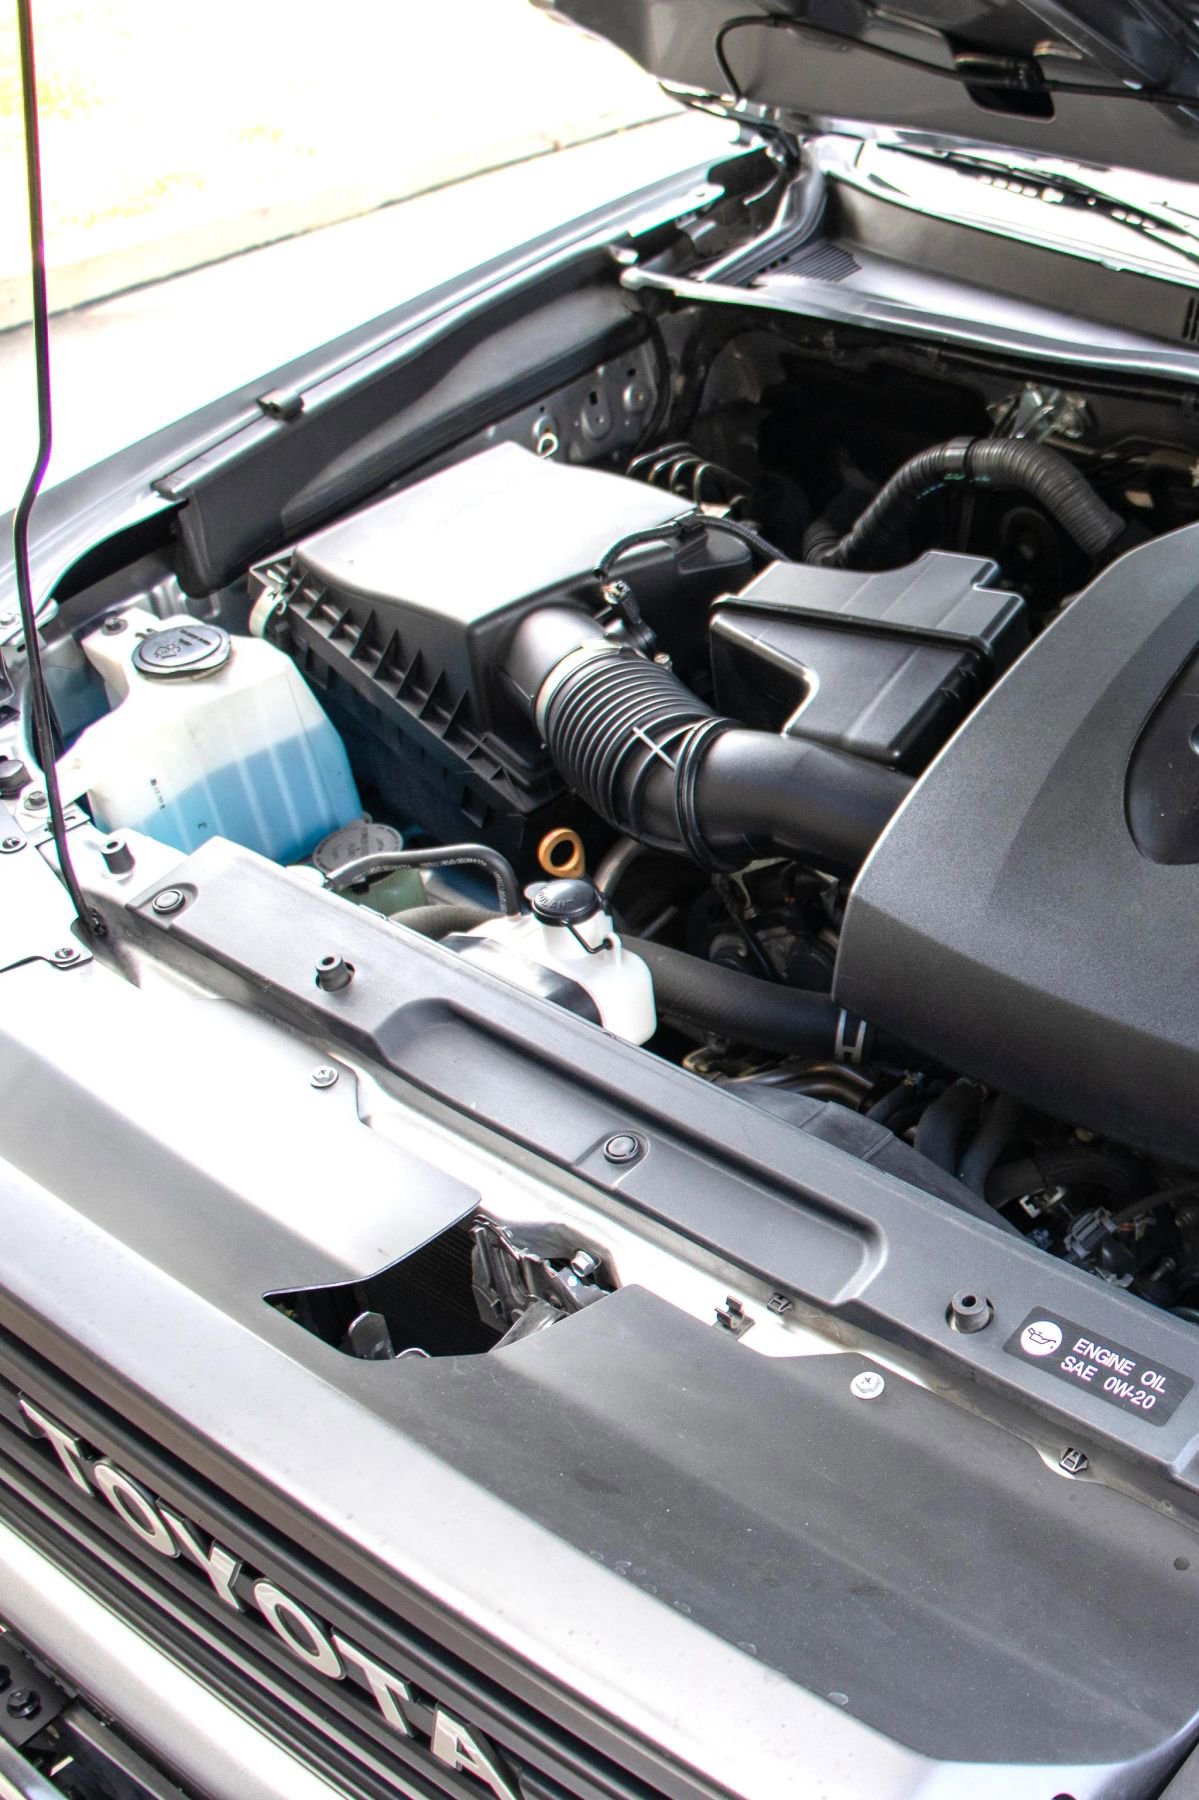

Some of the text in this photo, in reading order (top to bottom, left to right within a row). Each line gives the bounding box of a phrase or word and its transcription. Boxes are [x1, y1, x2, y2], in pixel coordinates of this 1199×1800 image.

[1061, 1355, 1156, 1410] SAE 0W-20
[1072, 1338, 1167, 1393] ENGINE OIL
[18, 1392, 523, 1800] TOYOTA
